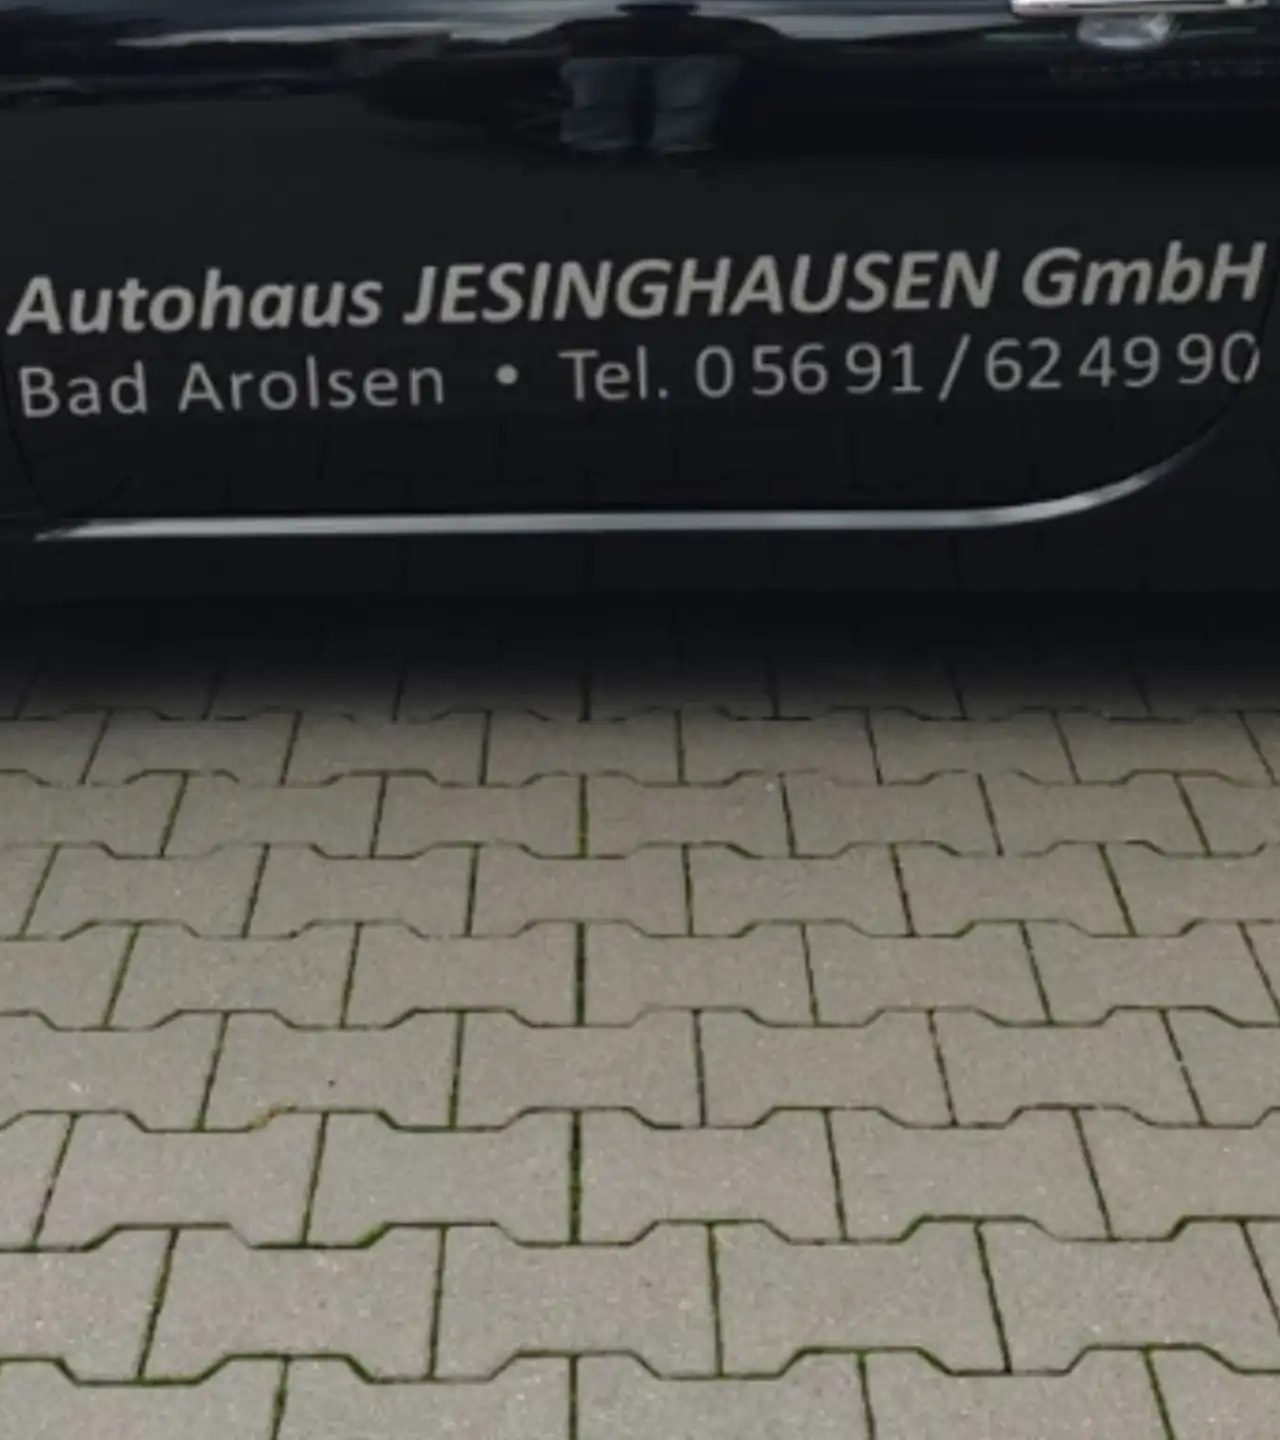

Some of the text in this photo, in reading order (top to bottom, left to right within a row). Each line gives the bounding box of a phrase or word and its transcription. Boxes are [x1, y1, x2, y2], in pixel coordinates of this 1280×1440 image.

[6, 240, 1267, 336] Autohaus JESINGHAUSEN GmbH
[19, 360, 147, 418] Bad
[178, 355, 444, 411] Arolsen
[559, 346, 669, 400] Tel.
